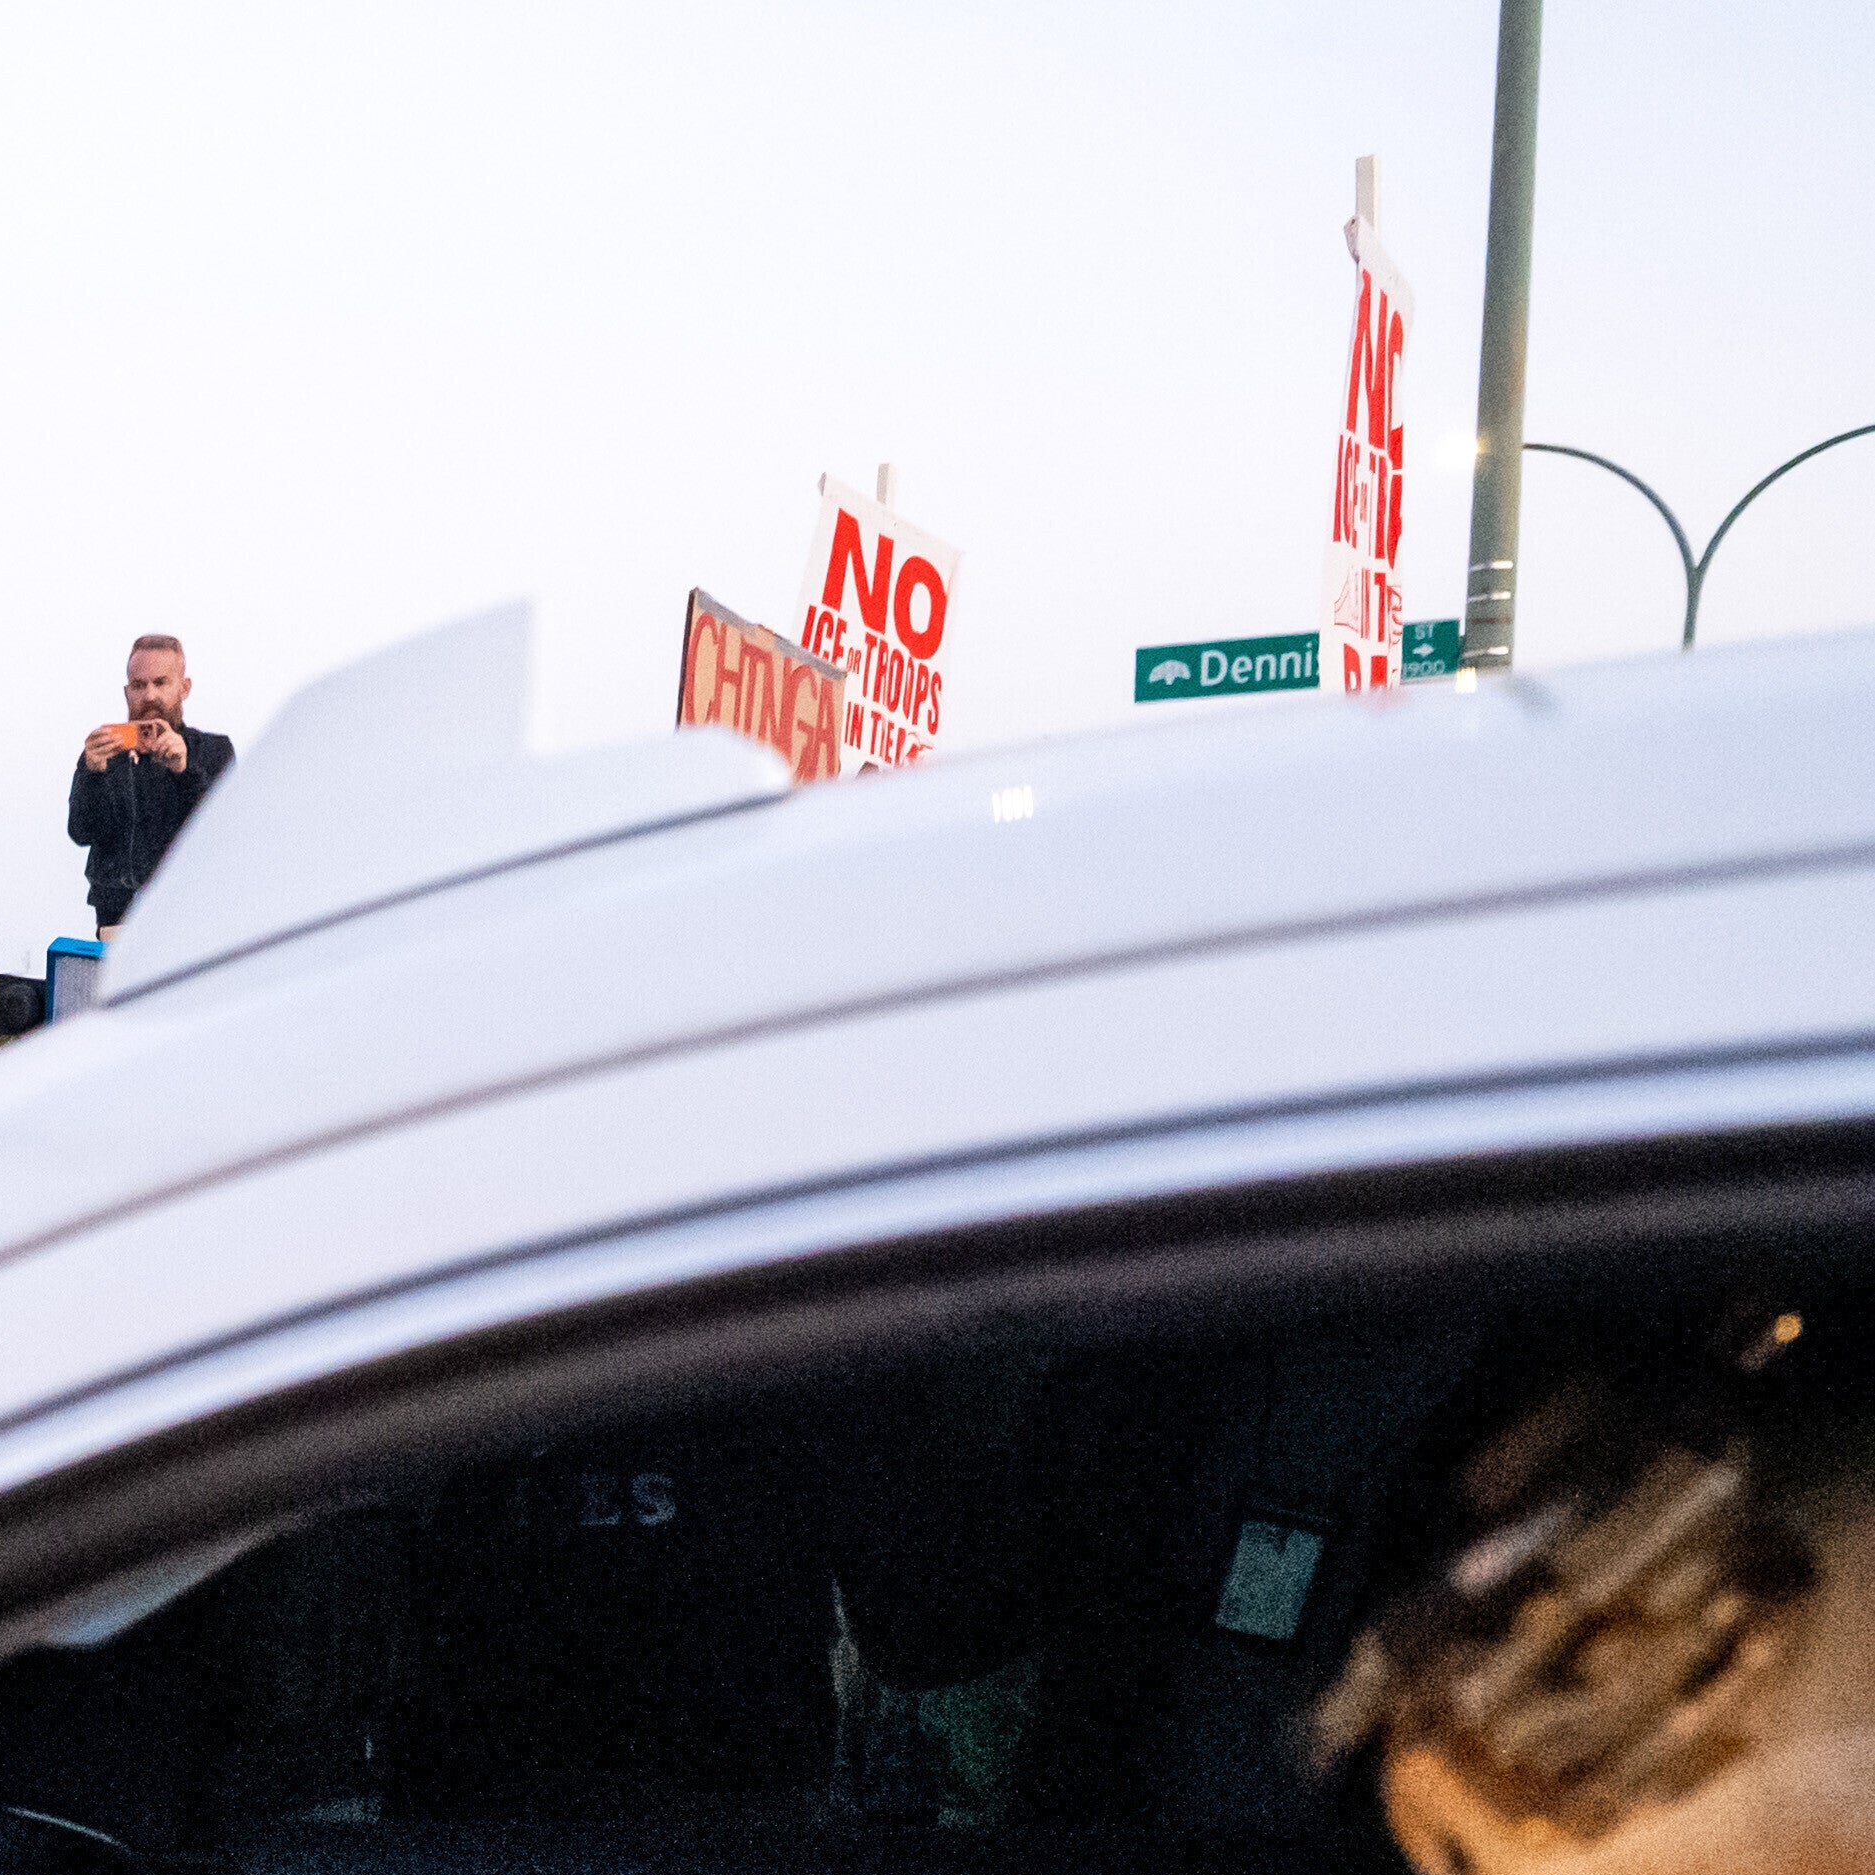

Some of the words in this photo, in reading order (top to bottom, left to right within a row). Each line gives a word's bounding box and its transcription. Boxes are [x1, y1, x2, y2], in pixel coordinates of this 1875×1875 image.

[822, 507, 948, 660] NO
[801, 604, 847, 665] ICE
[847, 647, 861, 675] OR
[862, 632, 942, 735] TROOPS
[1200, 638, 1319, 687] Denni
[1413, 624, 1435, 640] ST
[685, 611, 837, 781] CHINGA
[844, 701, 864, 749] IN
